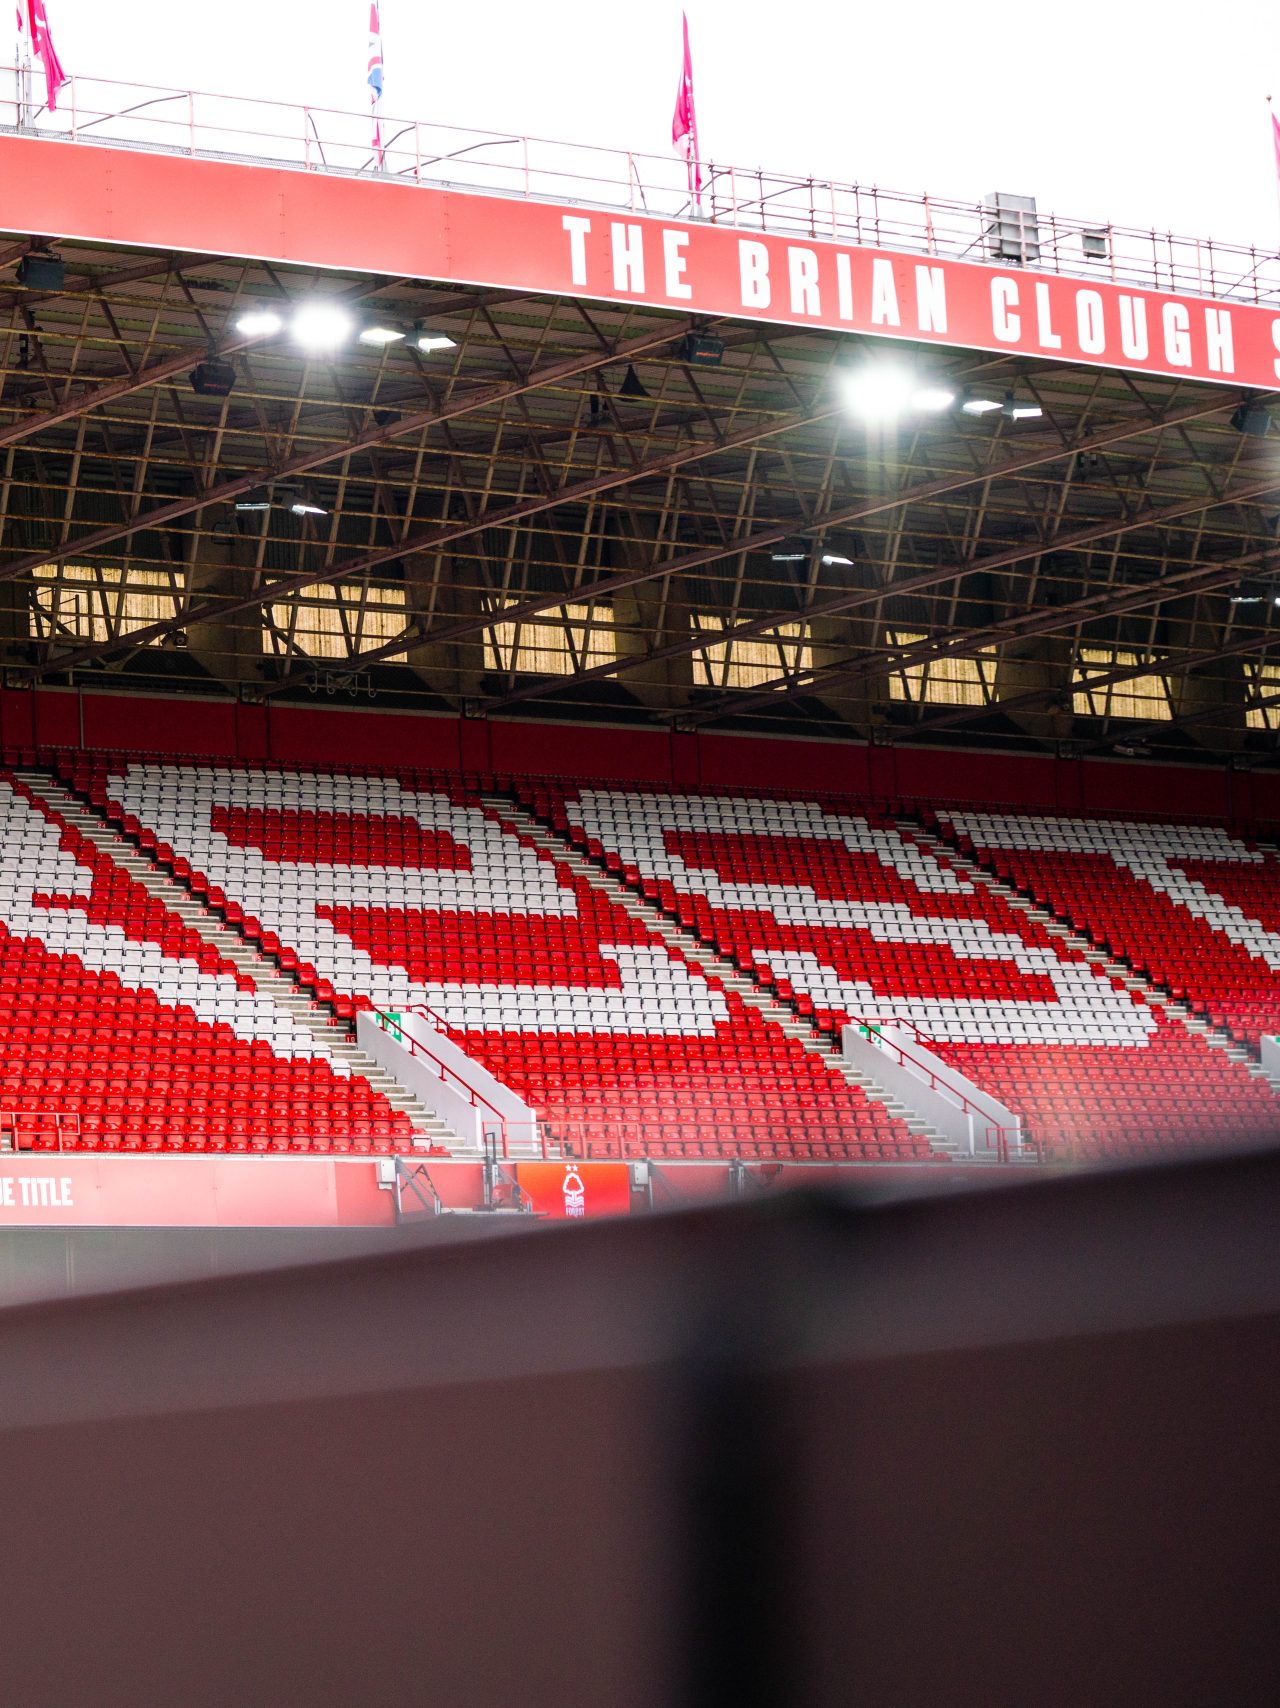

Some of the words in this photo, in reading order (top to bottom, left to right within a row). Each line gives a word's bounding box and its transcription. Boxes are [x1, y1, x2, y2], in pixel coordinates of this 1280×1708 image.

[562, 214, 692, 299] THE
[737, 239, 948, 333] BRIAN
[990, 276, 1235, 374] CLOUGH
[18, 1177, 74, 1207] TITLE
